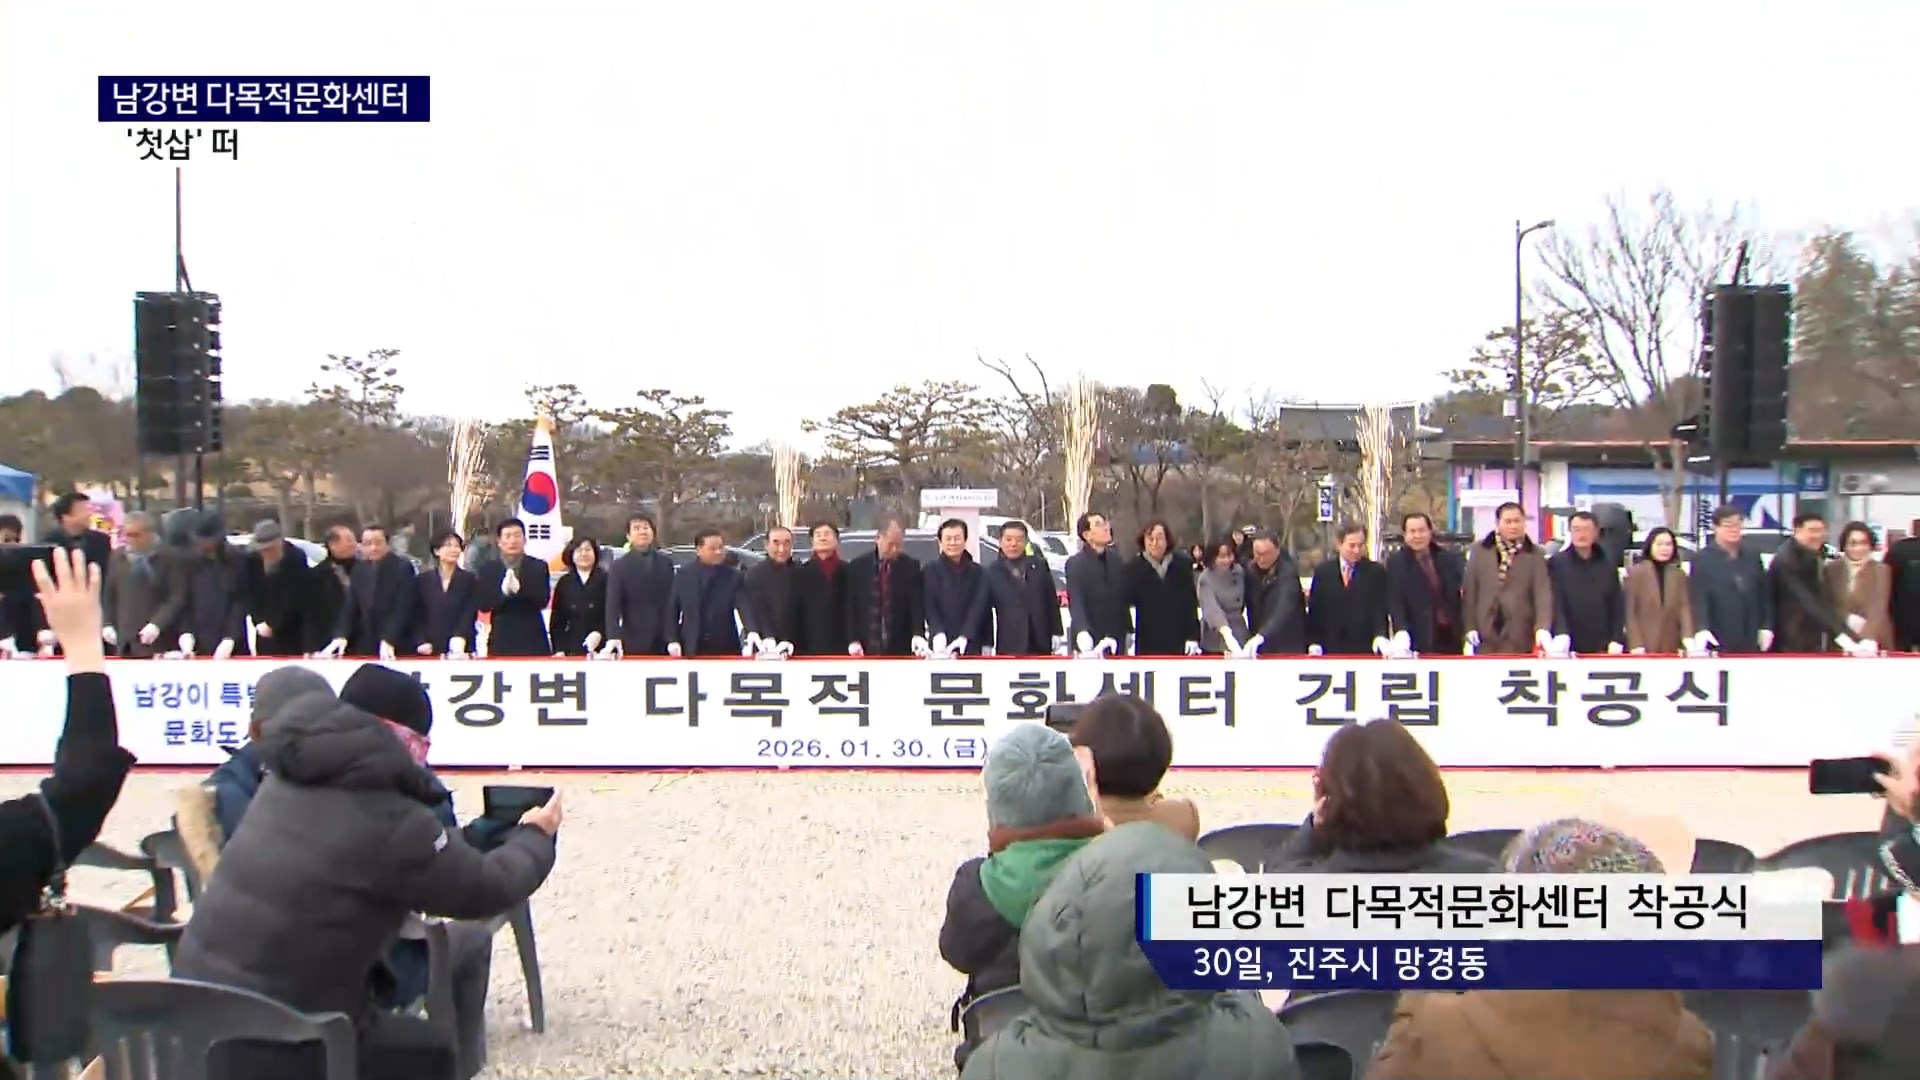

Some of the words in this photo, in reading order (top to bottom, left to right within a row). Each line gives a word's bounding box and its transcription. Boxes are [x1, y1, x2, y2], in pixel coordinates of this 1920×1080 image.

[134, 682, 208, 708] 남강이
[411, 671, 588, 727] 강변
[645, 671, 870, 727] 다목적
[1295, 670, 1439, 727] 건립
[1497, 670, 1729, 727] 착공식
[163, 720, 248, 746] 문화도
